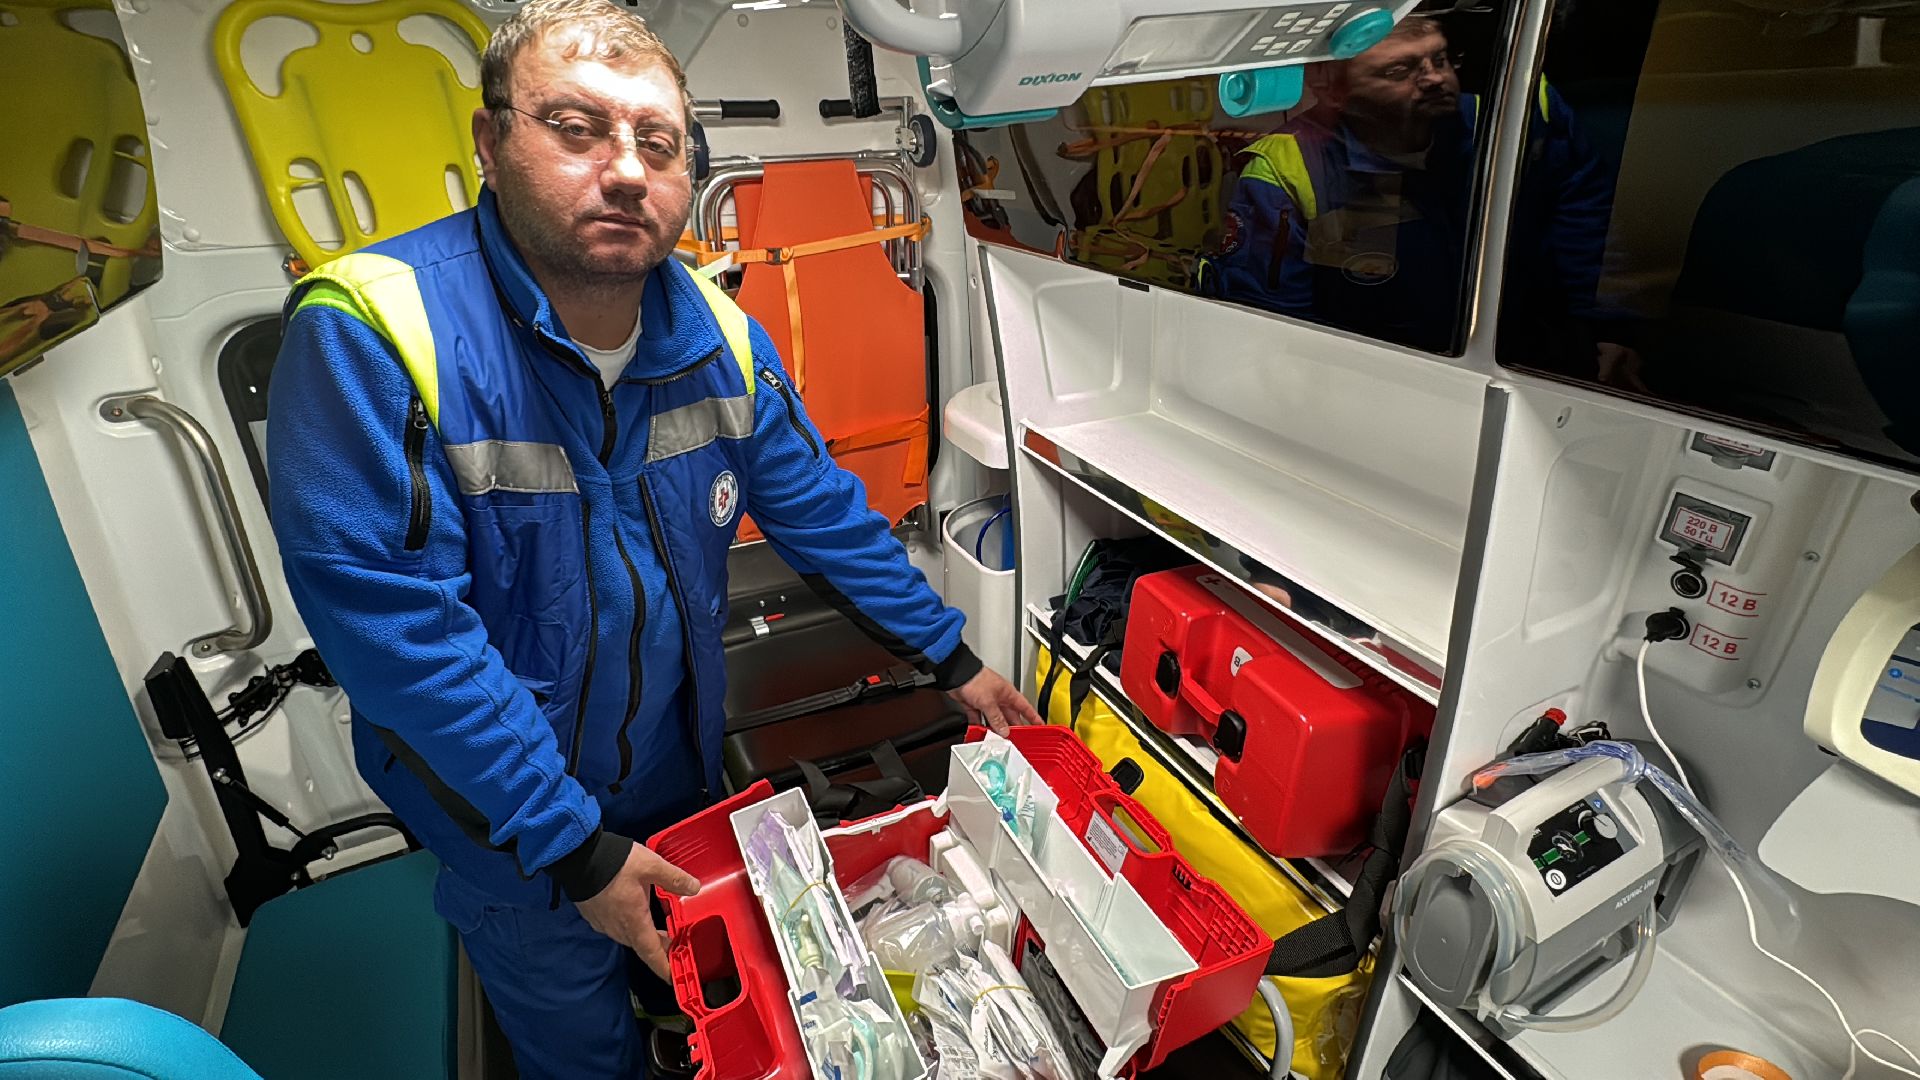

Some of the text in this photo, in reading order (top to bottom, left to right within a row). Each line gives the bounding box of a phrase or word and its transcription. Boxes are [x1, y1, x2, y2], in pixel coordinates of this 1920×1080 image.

[1018, 72, 1082, 86] DIXION
[1687, 516, 1718, 533] 220 В
[1683, 525, 1714, 544] 50 Гц
[1720, 591, 1757, 611] 12 В
[1702, 634, 1738, 655] 12 В
